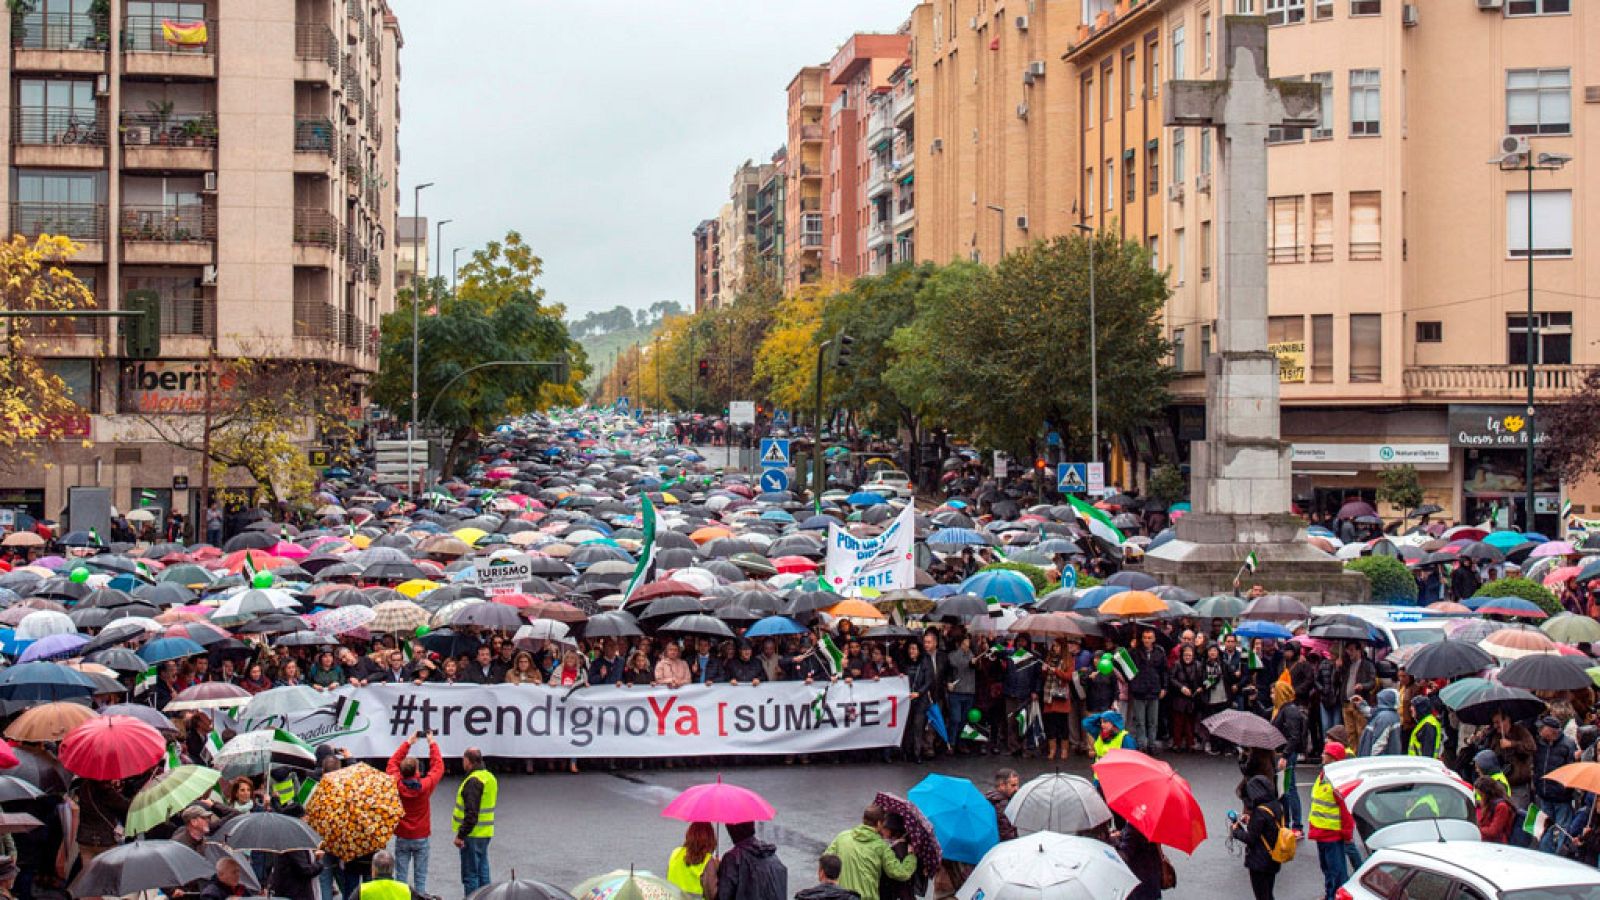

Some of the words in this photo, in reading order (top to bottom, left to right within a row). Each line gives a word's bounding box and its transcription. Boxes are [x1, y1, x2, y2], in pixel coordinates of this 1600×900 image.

[1498, 434, 1515, 444] con
[478, 565, 528, 577] TURISMO
[389, 694, 700, 748] #trendignoYa
